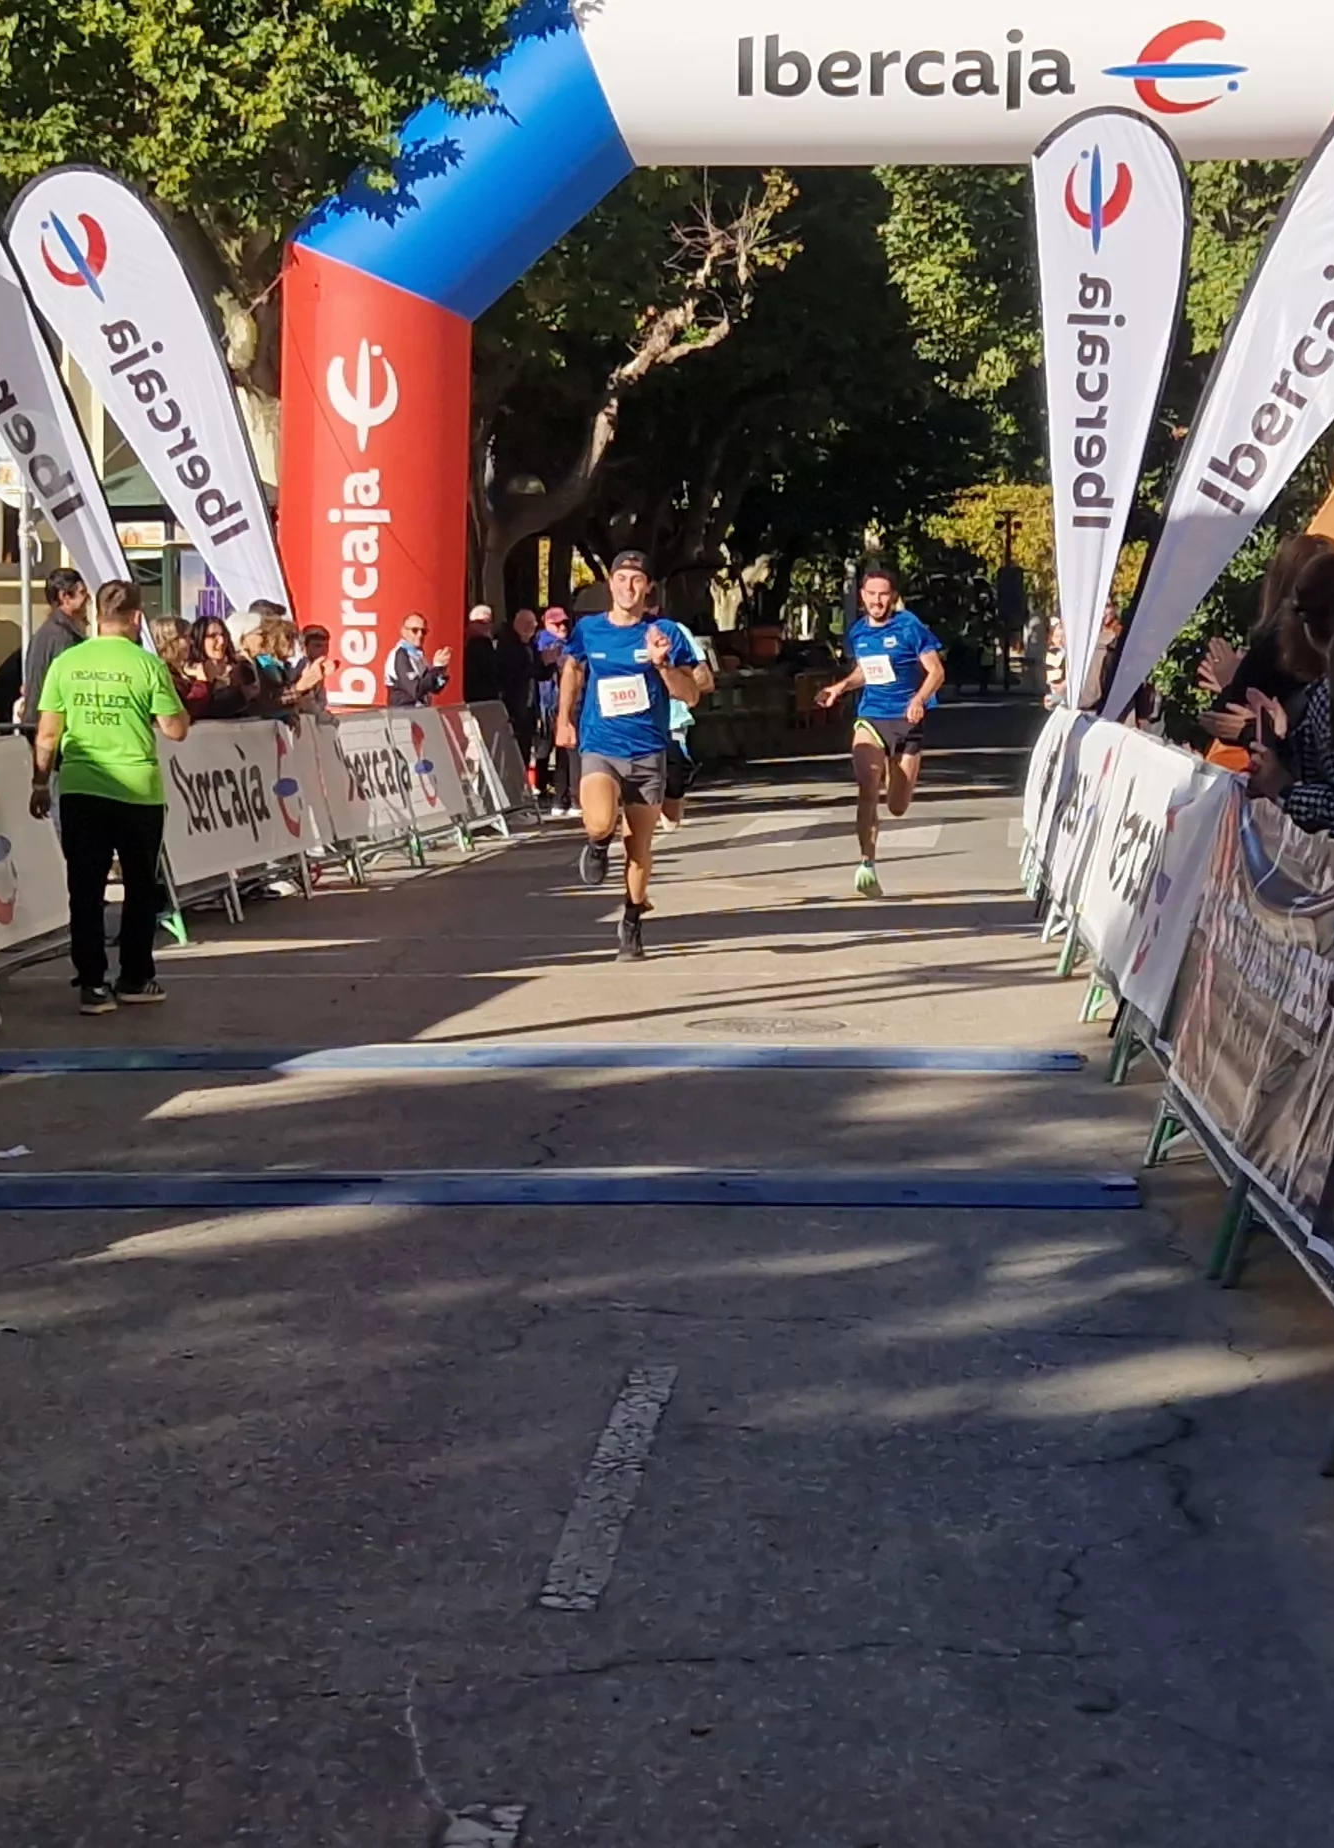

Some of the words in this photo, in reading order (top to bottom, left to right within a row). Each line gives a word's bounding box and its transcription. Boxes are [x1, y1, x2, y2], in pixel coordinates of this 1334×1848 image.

[737, 29, 1076, 111] Ibercaja
[326, 468, 392, 705] bercaja
[84, 710, 121, 726] SPORT
